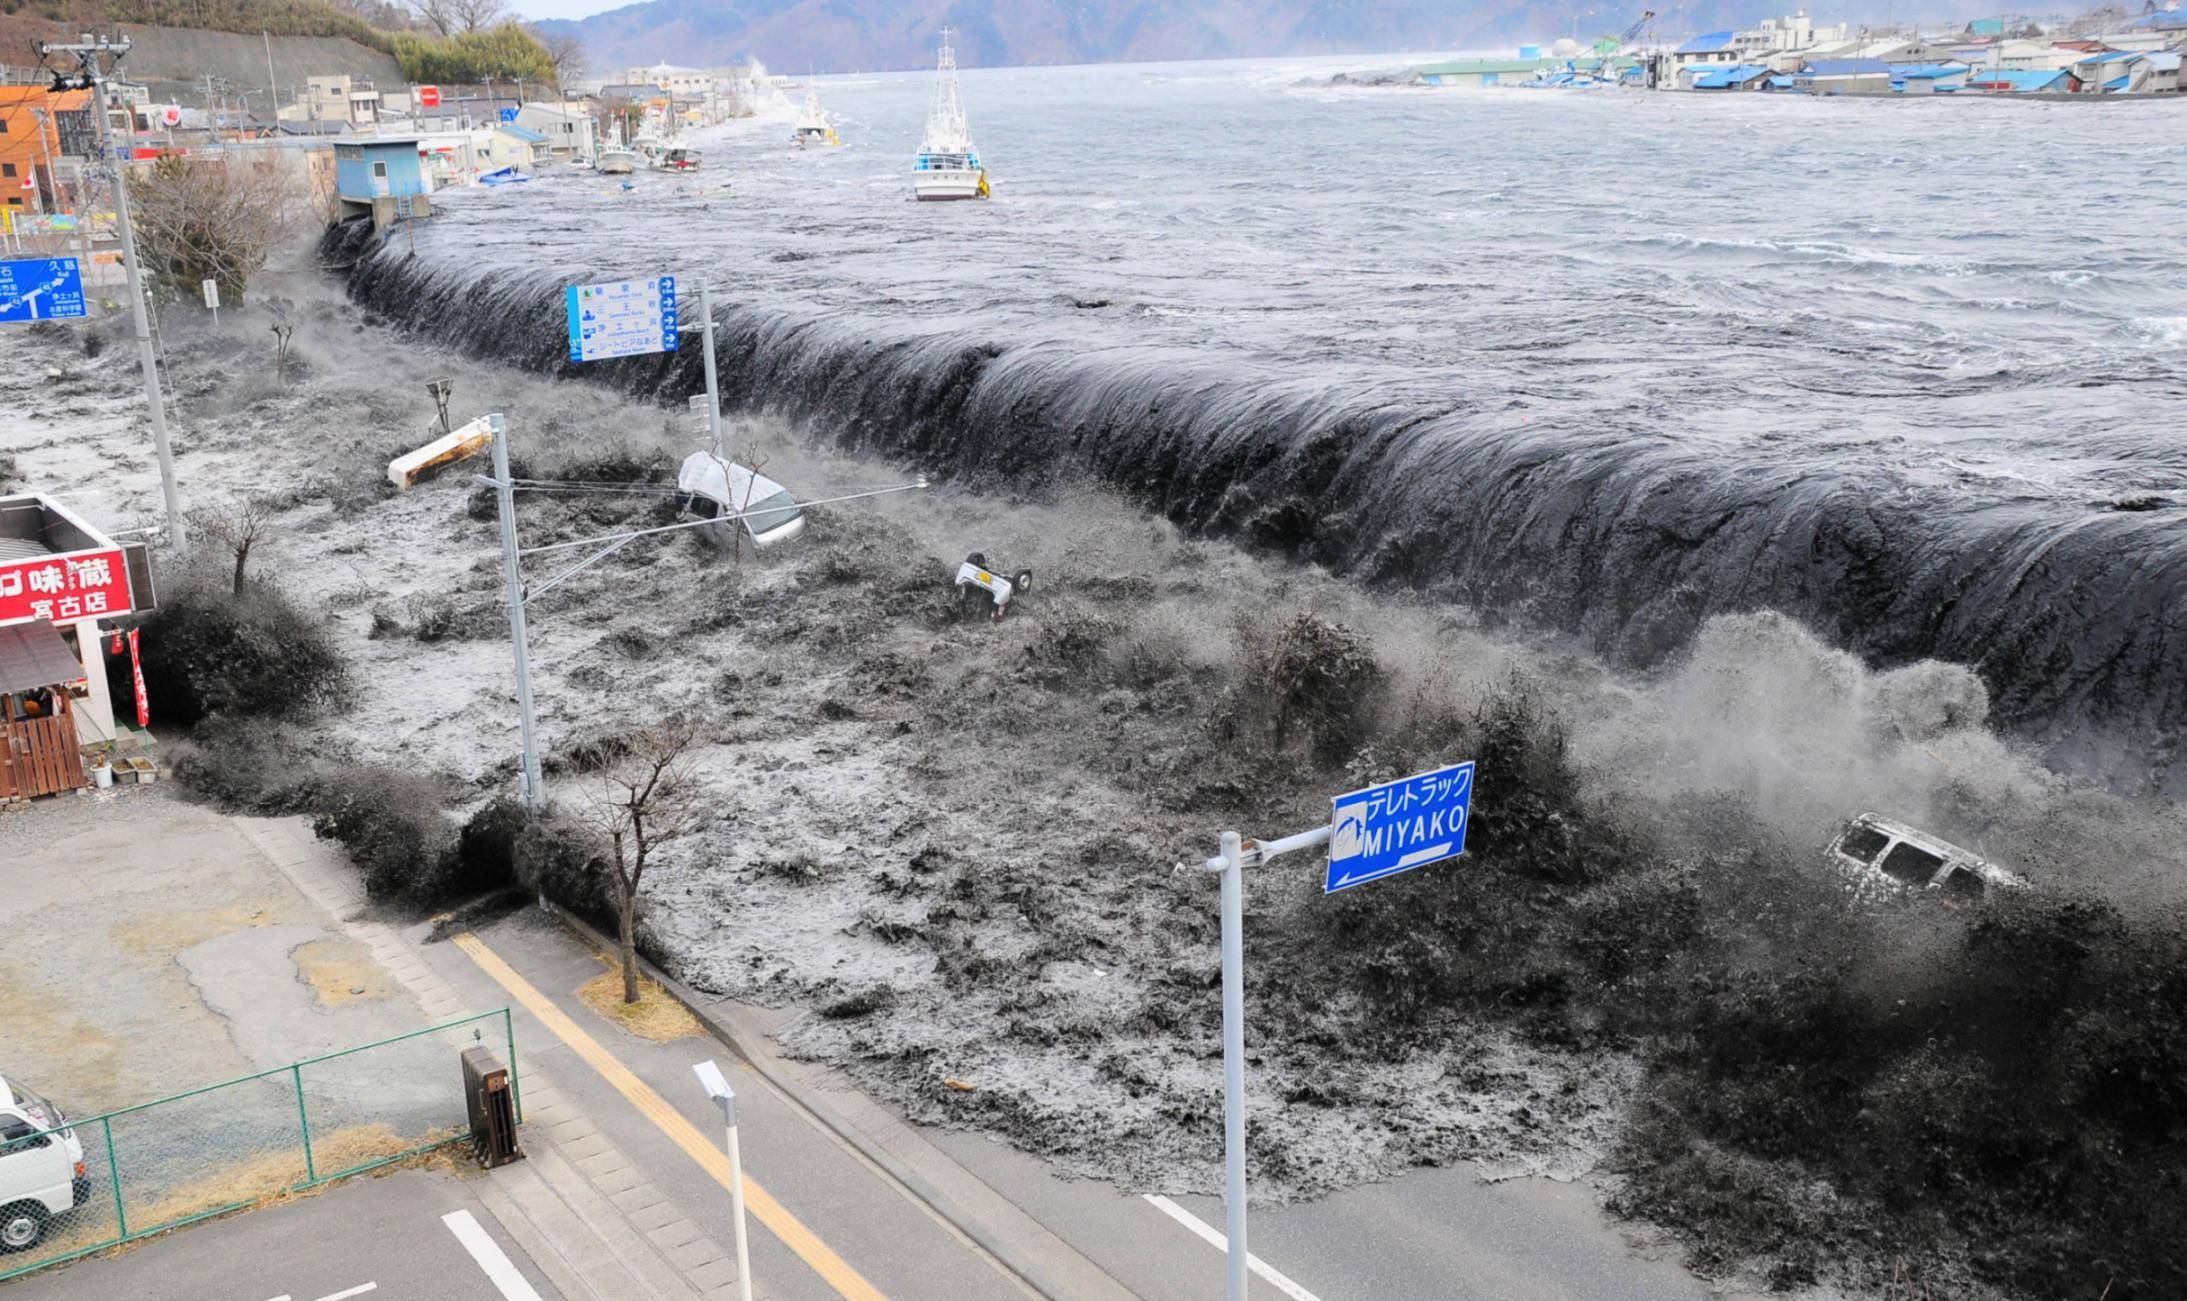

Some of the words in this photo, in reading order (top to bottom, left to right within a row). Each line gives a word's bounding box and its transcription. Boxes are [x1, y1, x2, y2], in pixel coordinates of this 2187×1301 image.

[30, 591, 109, 620] 宮古店
[1368, 768, 1471, 821] テレトラック
[1363, 804, 1465, 859] MIYAKO
